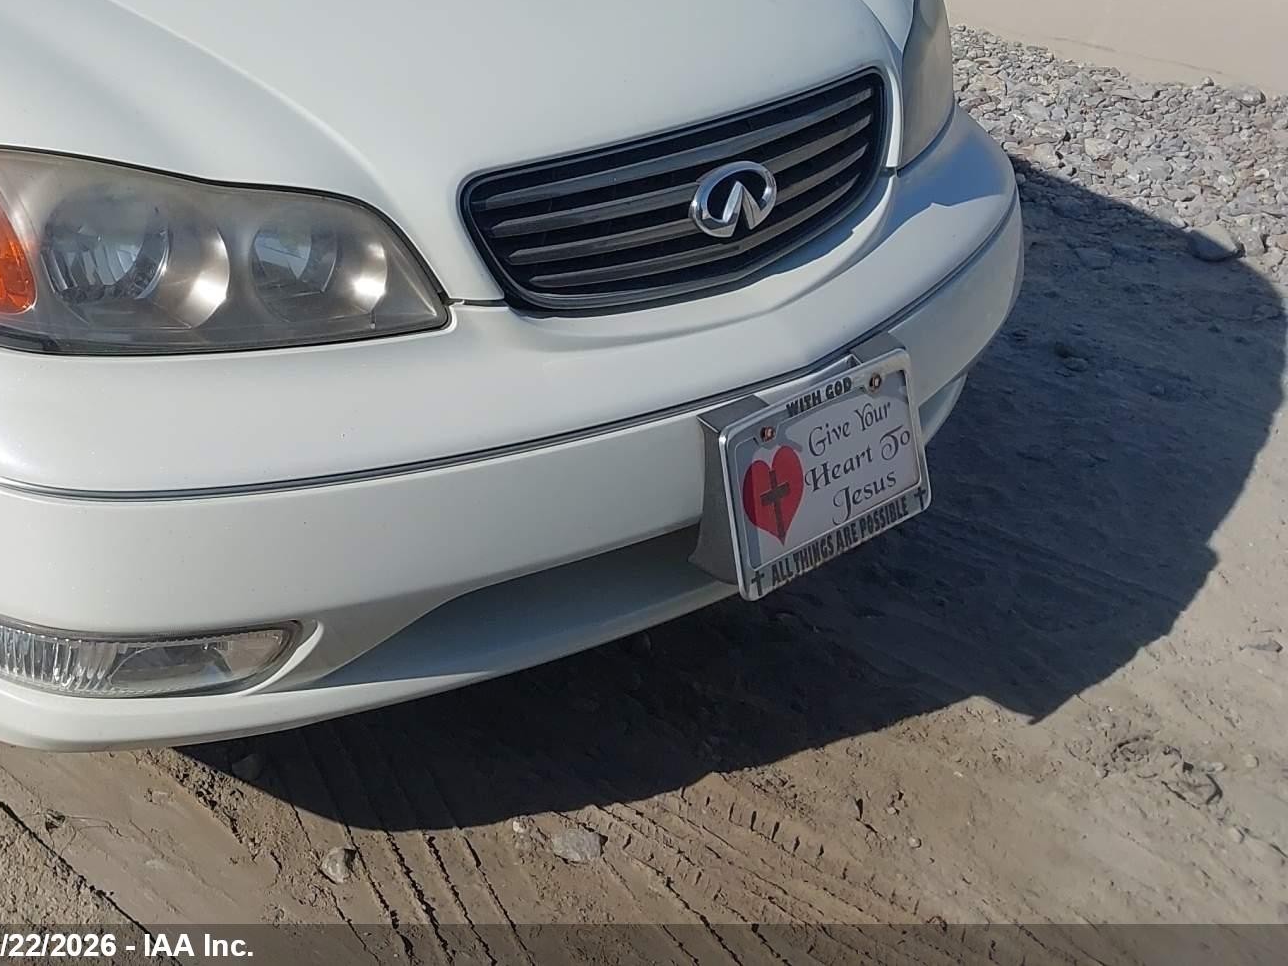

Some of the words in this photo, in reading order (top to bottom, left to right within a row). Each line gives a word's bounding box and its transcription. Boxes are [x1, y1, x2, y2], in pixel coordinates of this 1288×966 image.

[786, 391, 824, 418] WITH
[826, 376, 852, 401] GOD
[808, 419, 850, 457] Give
[855, 402, 891, 432] Your
[805, 447, 873, 492] Heart
[879, 425, 911, 461] To
[832, 471, 897, 526] Jesus
[771, 557, 792, 586] ALL
[792, 531, 834, 574] THINGS
[836, 521, 859, 553] ARE
[861, 497, 908, 542] POSSIBLE
